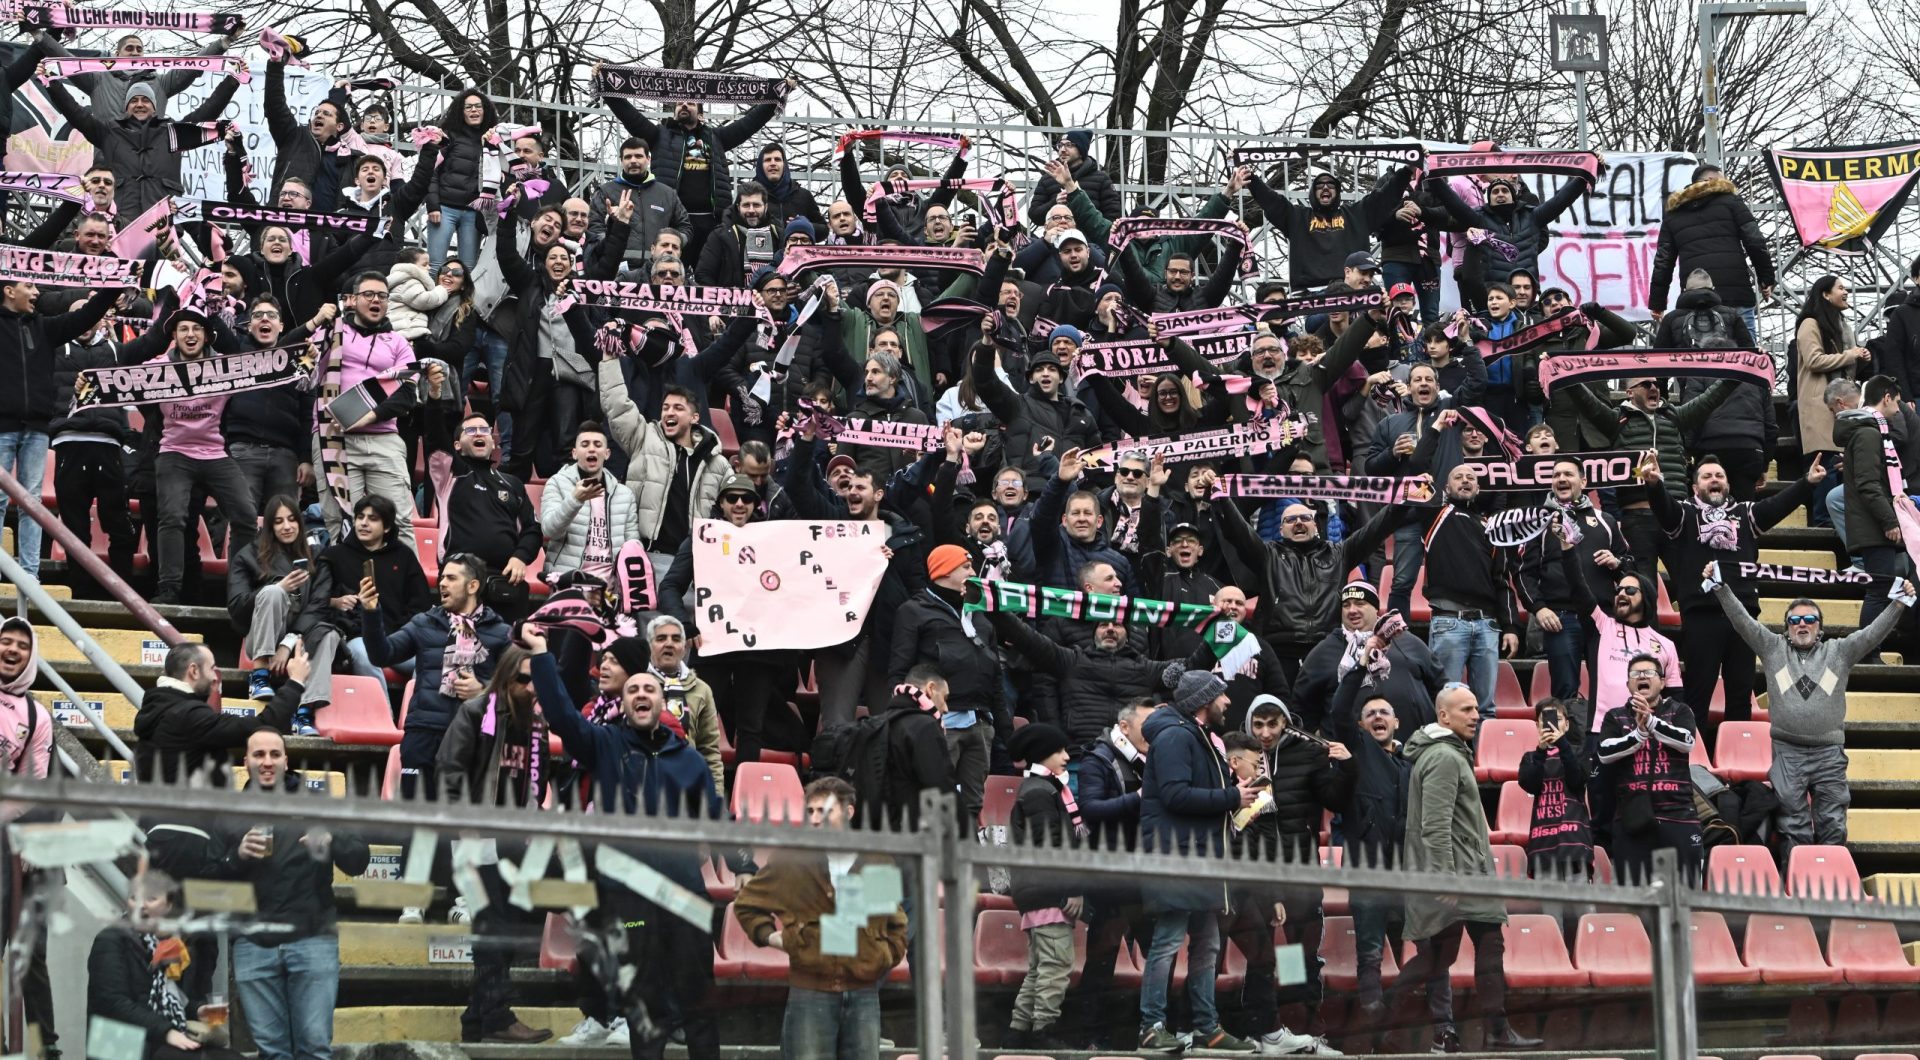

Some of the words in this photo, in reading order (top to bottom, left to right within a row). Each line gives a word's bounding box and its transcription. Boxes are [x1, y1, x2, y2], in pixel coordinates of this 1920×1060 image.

[82, 9, 109, 25] CHE
[1238, 152, 1302, 163] FORZA
[1331, 149, 1420, 162] PALERMO
[1436, 155, 1486, 167] Forza
[1512, 153, 1586, 166] Palermo
[211, 205, 368, 232] PALERMO
[0, 248, 44, 271] PAL
[53, 252, 133, 276] FORZA
[1555, 241, 1657, 312] SEN
[572, 278, 655, 300] FORZA
[659, 284, 754, 306] PALERM
[652, 300, 715, 313] PALERMO
[1287, 293, 1382, 311] PALERMO
[1155, 312, 1213, 332] SIAMO
[1217, 310, 1234, 321] IL
[1099, 347, 1170, 370] FORZA
[1199, 333, 1257, 356] PALER
[1668, 352, 1770, 370] PALERMO
[97, 365, 183, 394] FORZA
[187, 349, 288, 386] PALERMO
[117, 392, 135, 402] LA
[143, 387, 188, 399] SICILIA
[193, 380, 232, 394] SIAMO
[1113, 444, 1175, 460] FRZA
[1184, 431, 1270, 450] PALERMO
[1182, 449, 1227, 462] PALERMO
[1467, 457, 1631, 486] PALEMO
[1240, 475, 1392, 492] PALERMO
[1264, 488, 1309, 496] SICILIA
[1311, 489, 1352, 498] SIAMO
[1354, 491, 1377, 500] NOI
[583, 552, 612, 564] isate
[1738, 561, 1874, 584] PALERMO
[144, 653, 163, 663] FILA
[222, 708, 243, 716] TTORE
[1633, 750, 1668, 763] WID
[362, 868, 379, 879] ILA
[381, 870, 388, 879] 8
[432, 949, 455, 960] FILA
[458, 950, 464, 959] 7
